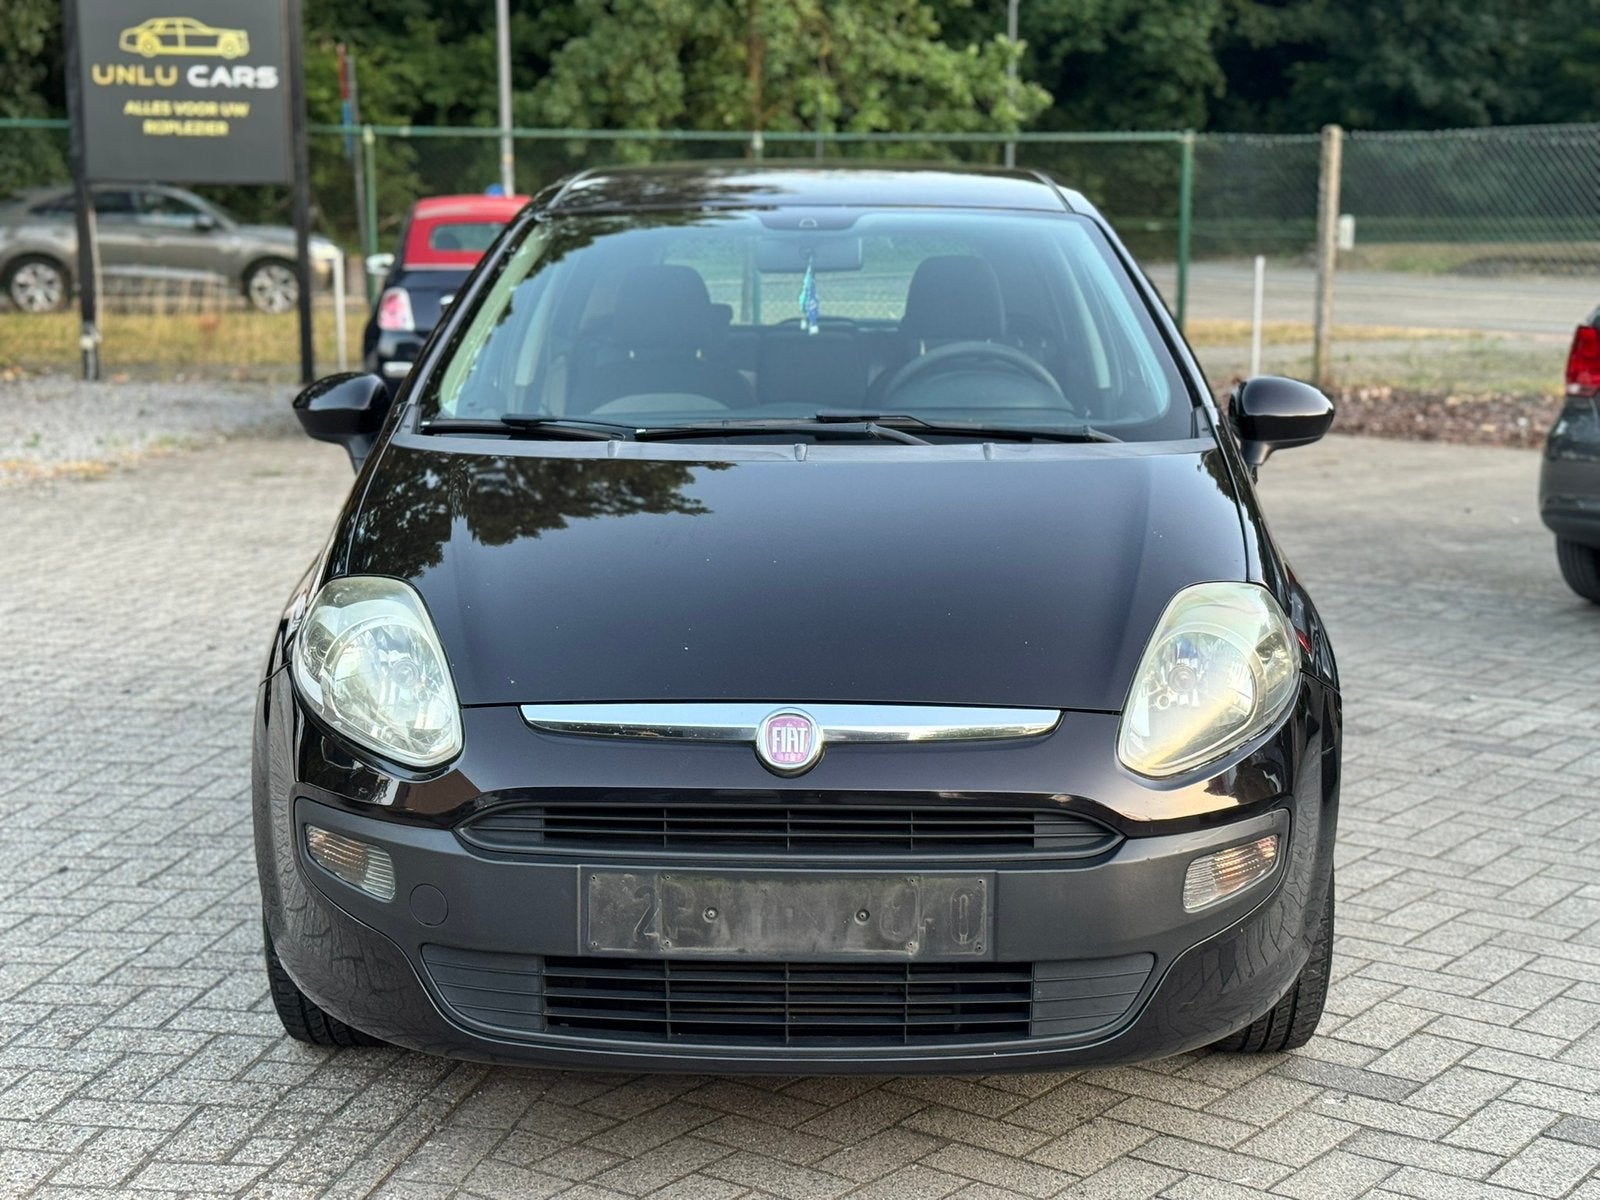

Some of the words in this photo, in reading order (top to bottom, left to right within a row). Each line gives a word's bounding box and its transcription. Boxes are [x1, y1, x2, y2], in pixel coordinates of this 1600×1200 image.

[92, 64, 178, 87] UNLU
[187, 65, 279, 89] CARS
[772, 726, 808, 753] FIAT
